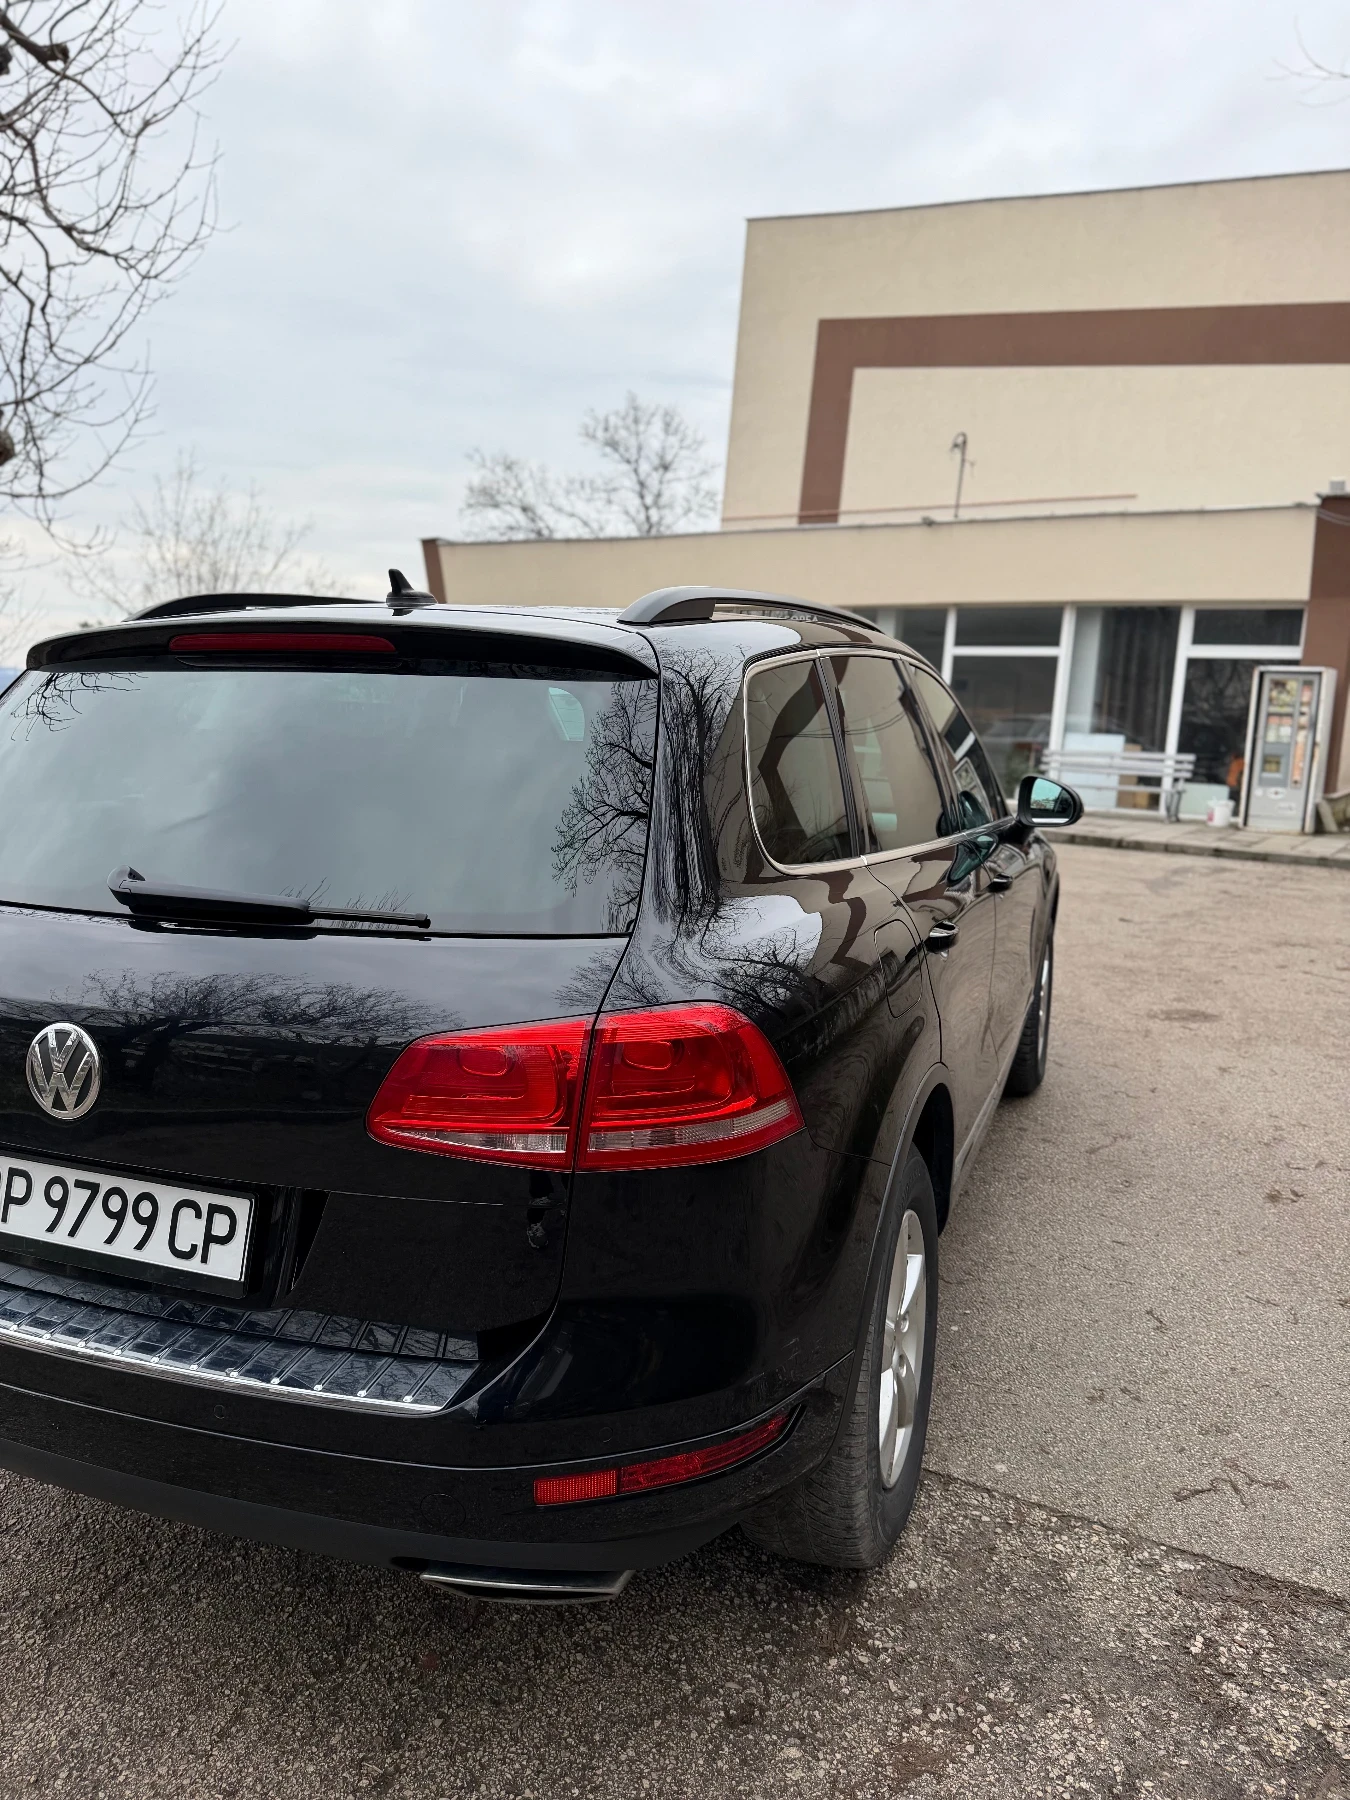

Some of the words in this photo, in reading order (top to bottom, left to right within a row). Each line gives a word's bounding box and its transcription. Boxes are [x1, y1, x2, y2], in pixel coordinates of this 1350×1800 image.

[27, 1023, 99, 1119] VW
[0, 1166, 33, 1223] P
[43, 1175, 159, 1251] 9799
[168, 1198, 237, 1264] CP
